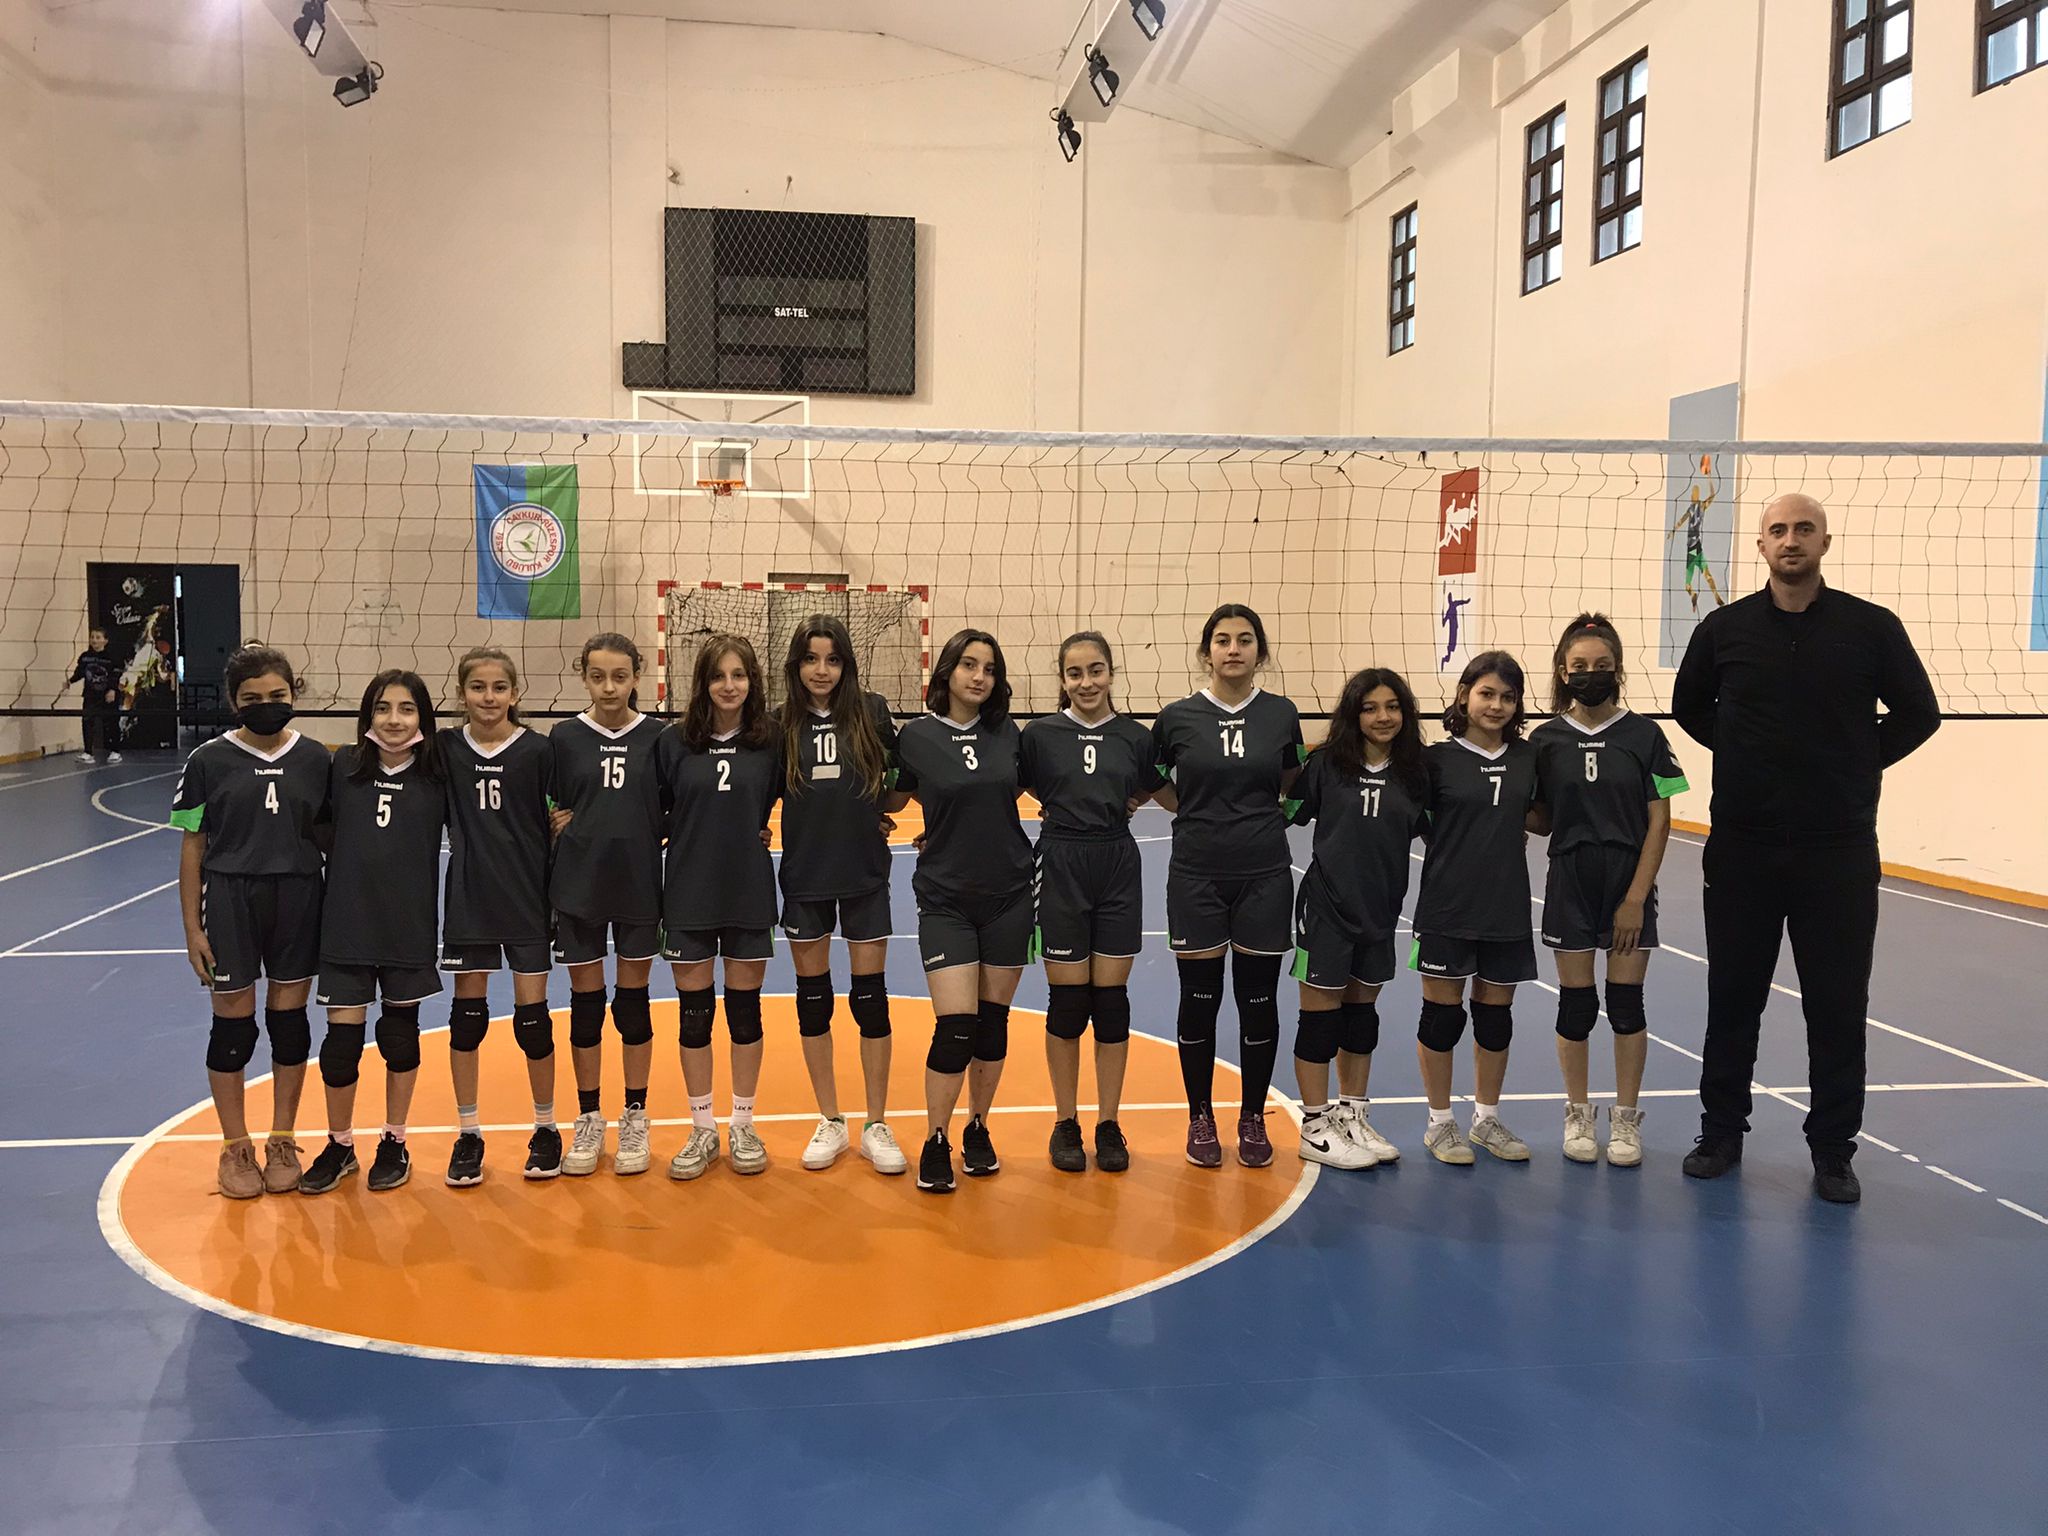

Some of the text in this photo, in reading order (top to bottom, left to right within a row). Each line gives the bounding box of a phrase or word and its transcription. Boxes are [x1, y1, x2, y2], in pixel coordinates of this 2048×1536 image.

[1218, 717, 1246, 726] hummel
[951, 733, 978, 742] hummel
[1077, 733, 1104, 741] hummel
[1219, 727, 1245, 758] 14
[1577, 741, 1606, 749] hummel
[599, 744, 628, 753] hummel
[708, 746, 737, 755] hummel
[813, 732, 838, 764] 10
[961, 745, 979, 771] 3
[1083, 744, 1097, 775] 9
[254, 767, 284, 776] hummel
[475, 763, 504, 773] hummel
[600, 756, 626, 789] 15
[716, 759, 731, 792] 2
[1480, 764, 1507, 773] hummel
[373, 779, 404, 791] hummel
[1359, 776, 1387, 787] hummel
[1489, 775, 1502, 806] 7
[264, 781, 280, 815] 4
[475, 778, 501, 810] 16
[1360, 787, 1381, 818] 11
[376, 793, 393, 828] 5
